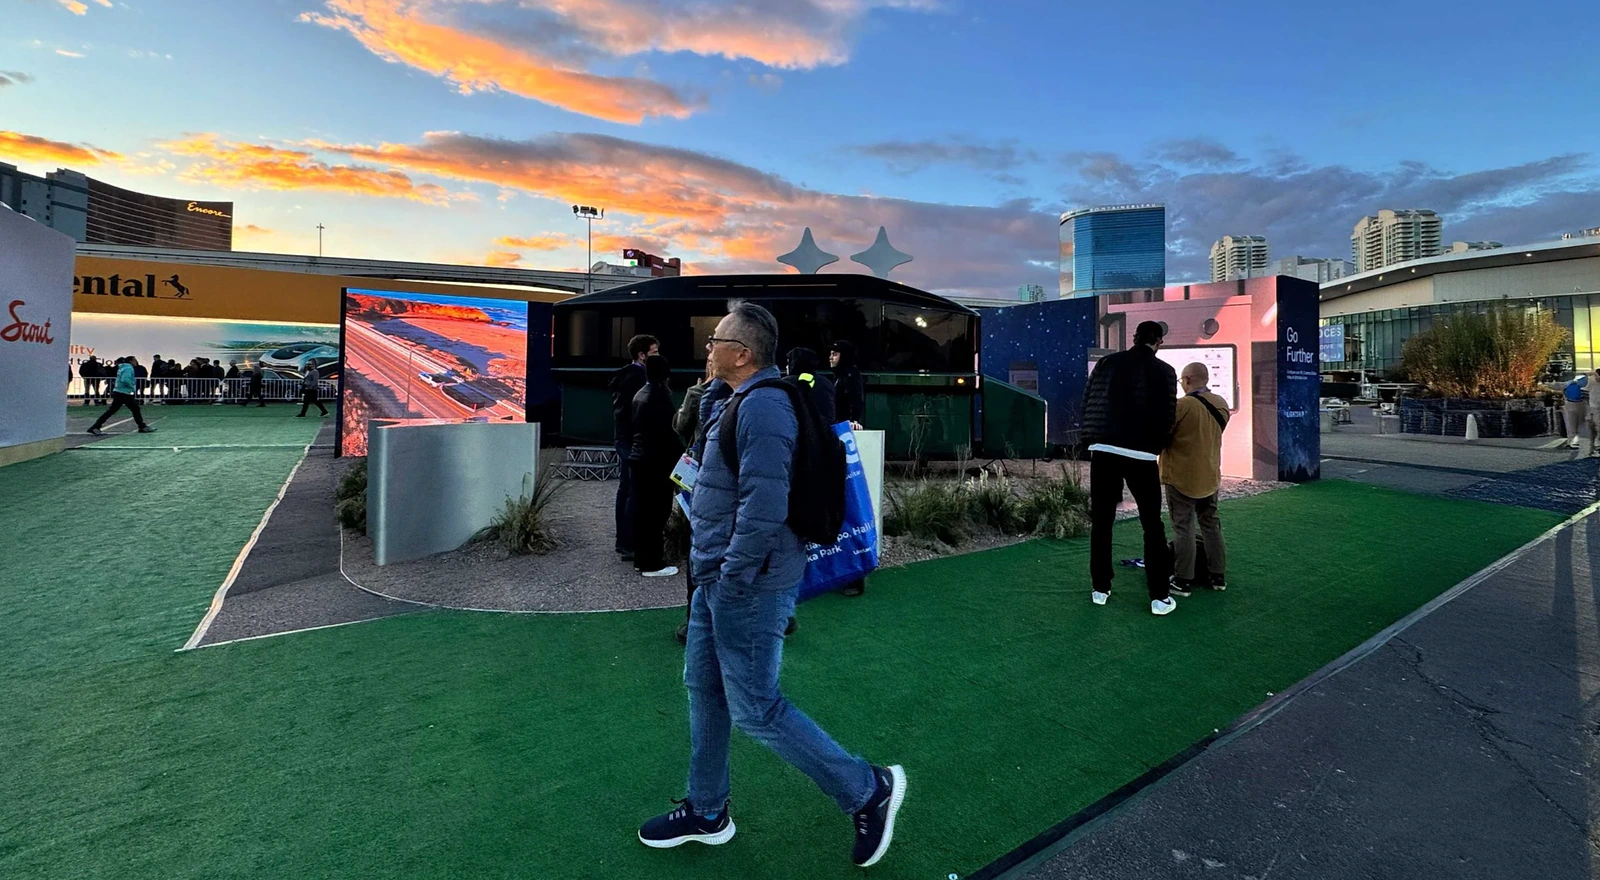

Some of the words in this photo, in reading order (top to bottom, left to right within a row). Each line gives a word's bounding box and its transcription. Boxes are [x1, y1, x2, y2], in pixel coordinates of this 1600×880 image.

[187, 201, 232, 218] Encore
[1089, 203, 1156, 212] FONTAINEBLEAU
[0, 299, 54, 344] Scout
[1286, 326, 1298, 343] Go
[1286, 346, 1314, 363] Further
[852, 522, 872, 536] Hall
[820, 544, 842, 557] Park
